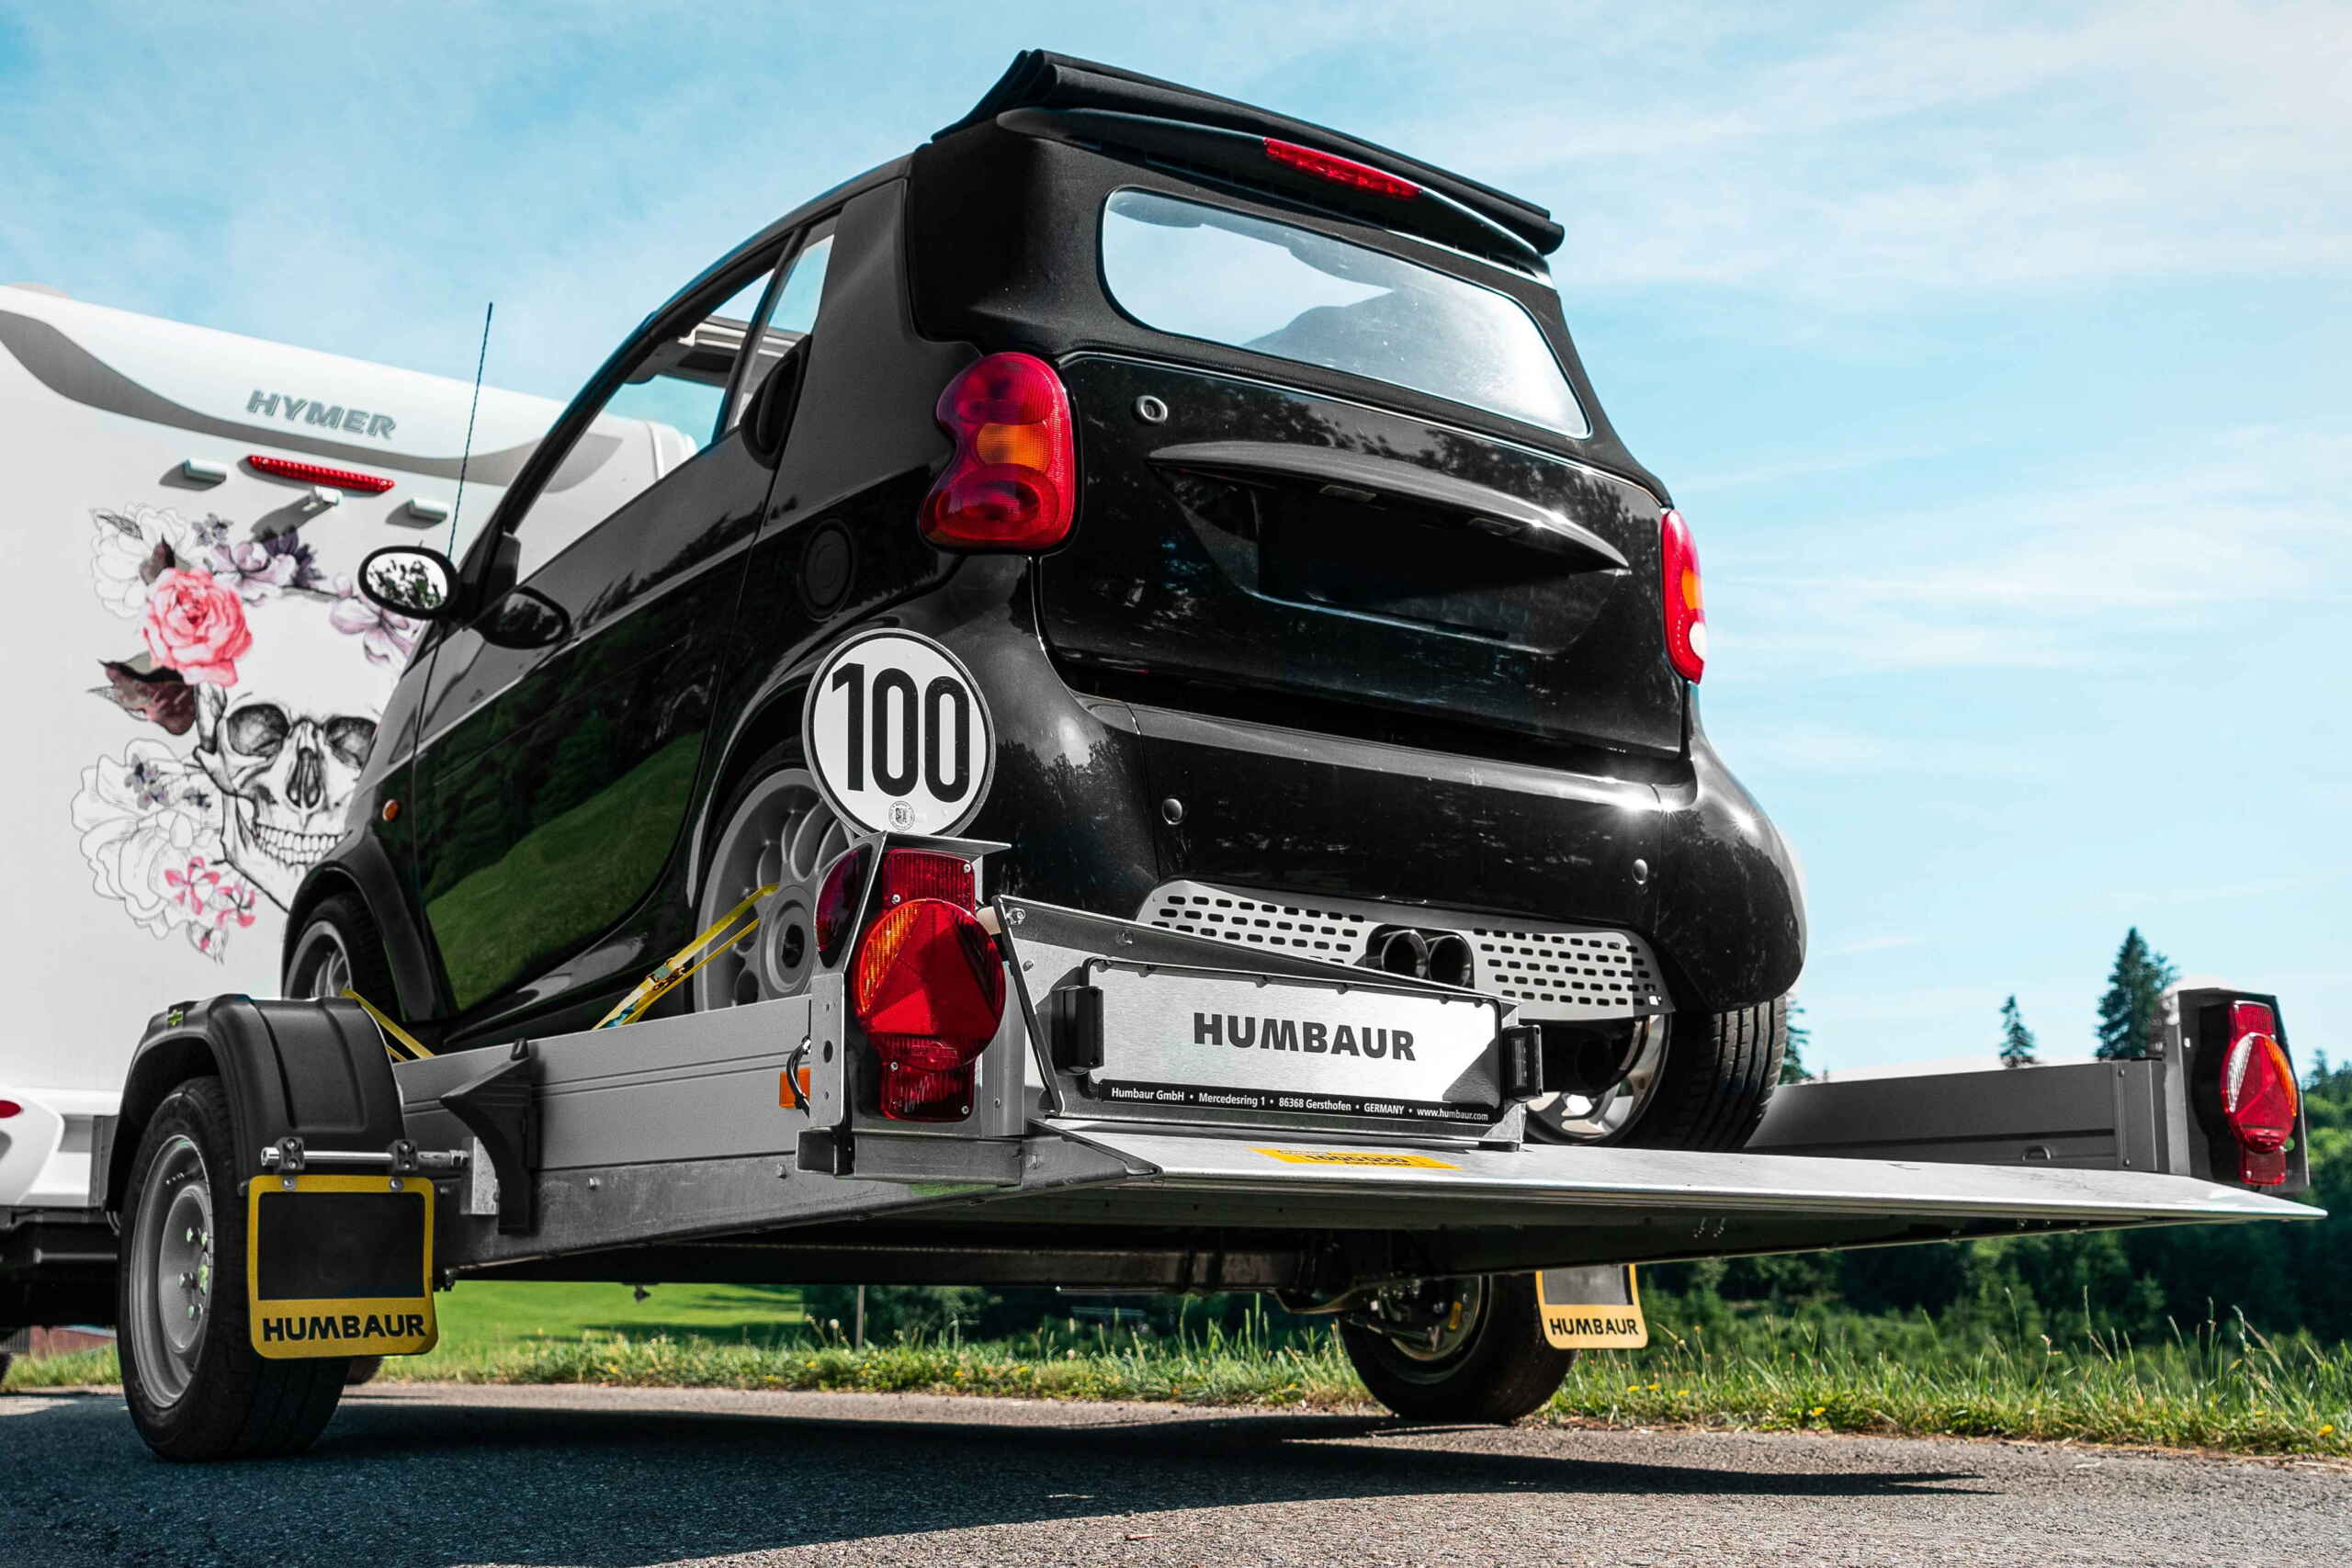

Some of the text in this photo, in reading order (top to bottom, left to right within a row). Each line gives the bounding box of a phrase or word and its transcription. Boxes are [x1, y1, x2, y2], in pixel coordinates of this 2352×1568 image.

[245, 389, 397, 440] HYMER
[831, 662, 971, 803] 100
[1193, 1011, 1417, 1062] HUMBAUR
[1111, 1088, 1489, 1122] Humbaur GmbH Mercedesring 1 86368 Gersthofen GERMANY www.humbaur.com
[262, 1314, 427, 1342] HUMBAUR
[1549, 1318, 1639, 1336] HUMBAUR
